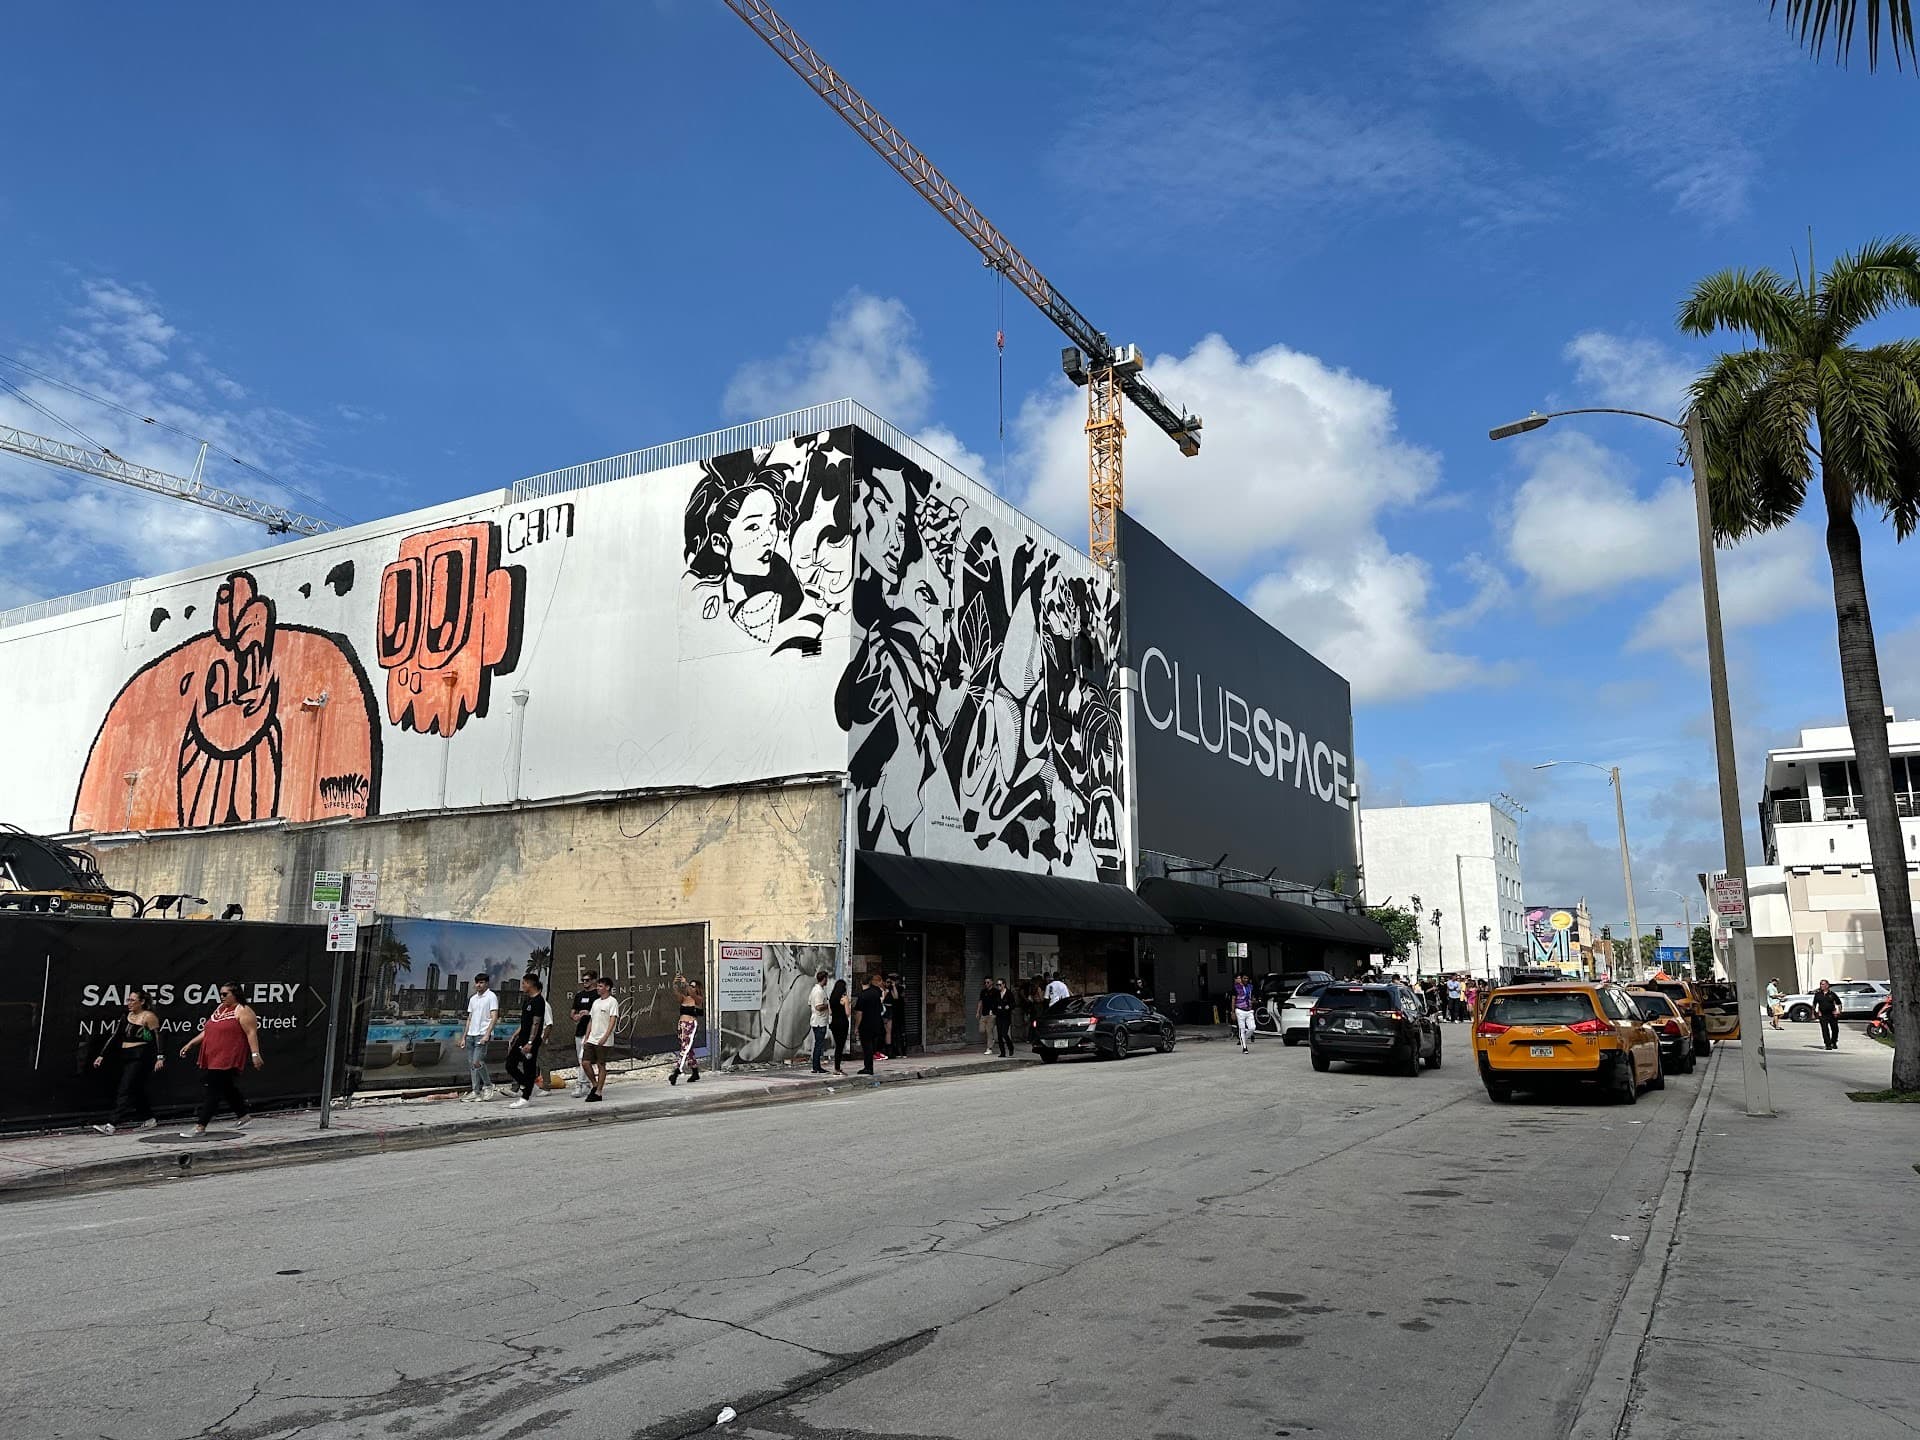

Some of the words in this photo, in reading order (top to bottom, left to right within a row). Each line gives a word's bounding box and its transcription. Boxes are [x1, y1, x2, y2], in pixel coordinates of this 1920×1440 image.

[69, 902, 85, 910] JOHN
[86, 903, 107, 911] DEERE
[725, 948, 760, 957] WARNING
[576, 947, 683, 984] E11EVEN
[183, 983, 301, 1005] GAERY
[79, 1020, 93, 1036] N
[159, 1017, 192, 1033] Ave
